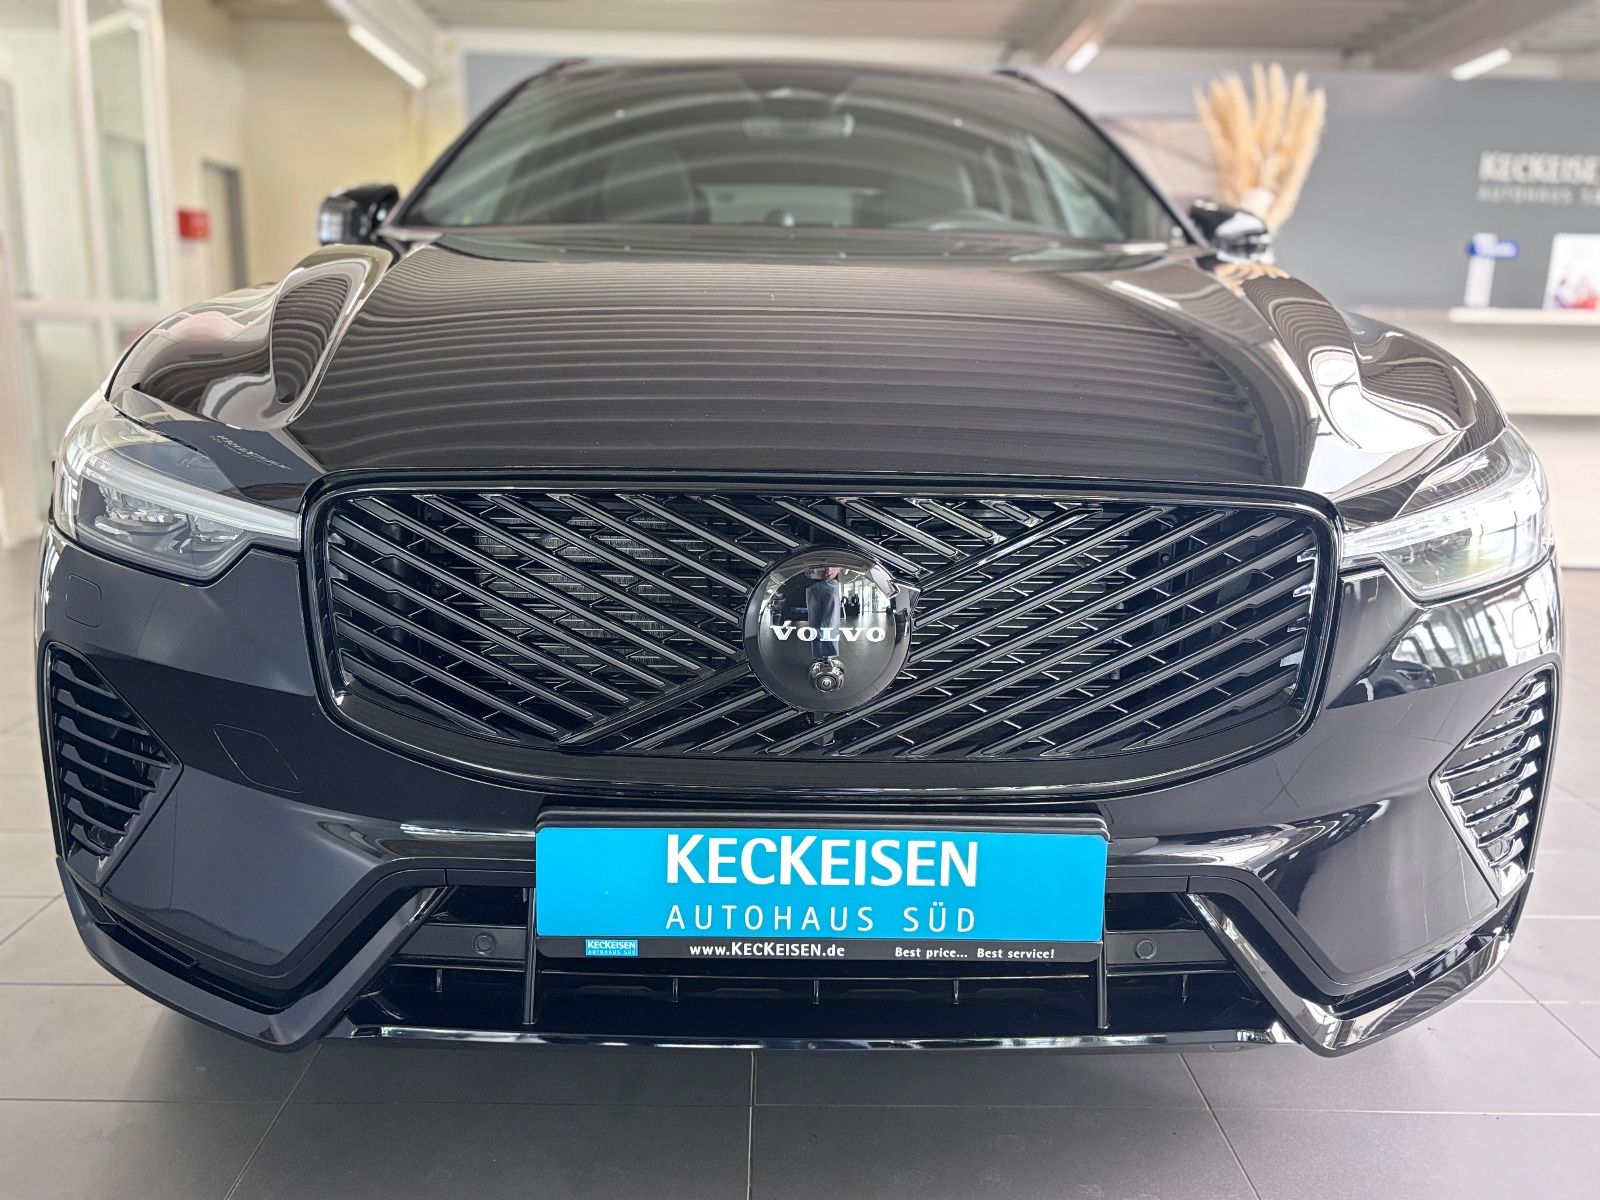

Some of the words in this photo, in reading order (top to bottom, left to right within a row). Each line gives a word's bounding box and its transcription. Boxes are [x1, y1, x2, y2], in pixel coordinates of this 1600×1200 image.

[770, 624, 886, 642] VOLVO
[666, 834, 978, 887] KECKEISEN
[665, 904, 874, 931] AUTOHAUS
[903, 901, 975, 933] SÜD
[587, 940, 636, 949] KECKEISEN
[689, 942, 845, 957] www.KECKEISEN.de
[895, 947, 921, 958] Best
[926, 947, 968, 960] price...
[977, 948, 1003, 959] Best
[1008, 949, 1055, 959] service!
